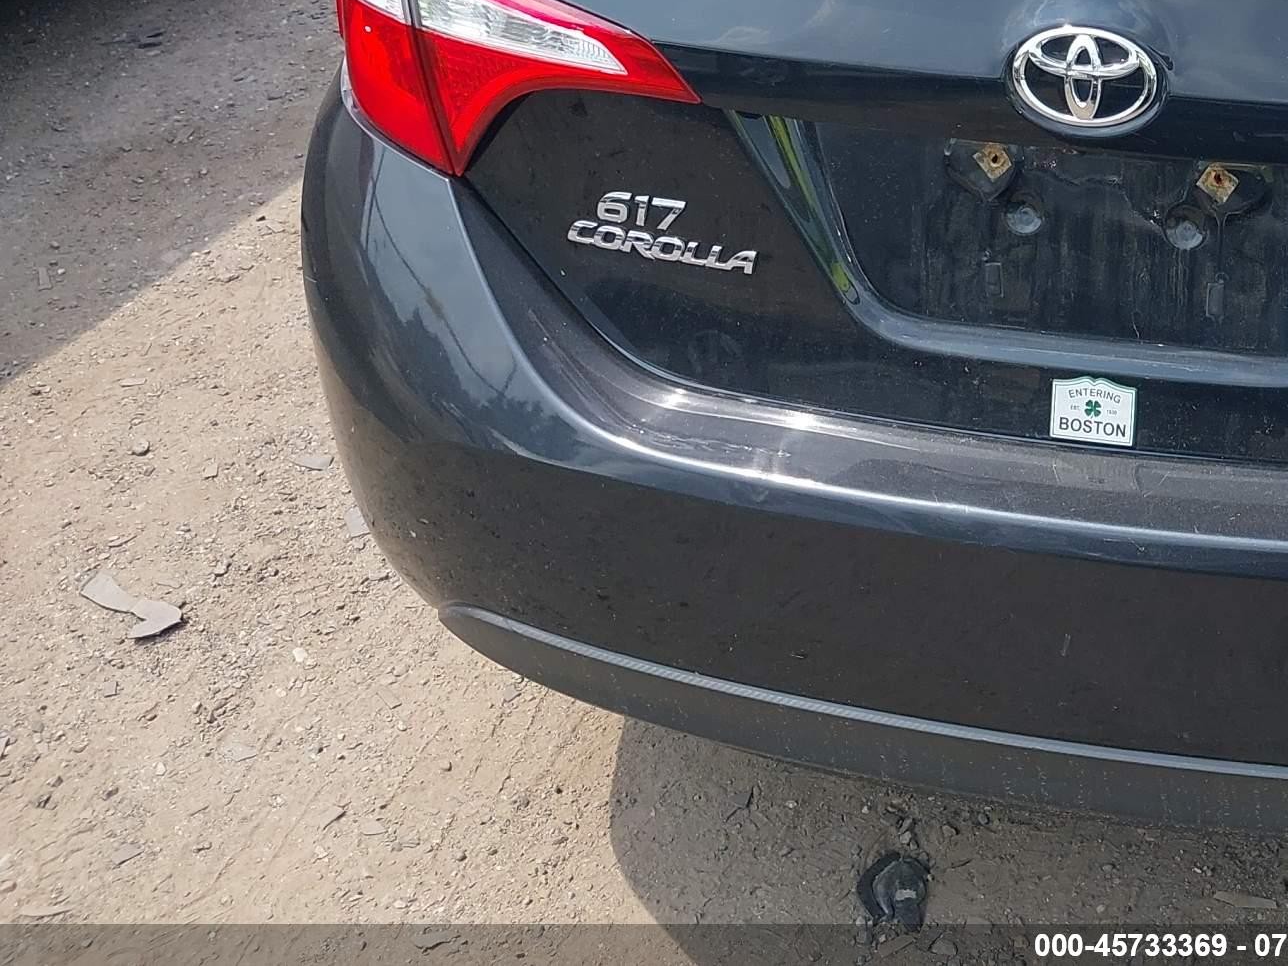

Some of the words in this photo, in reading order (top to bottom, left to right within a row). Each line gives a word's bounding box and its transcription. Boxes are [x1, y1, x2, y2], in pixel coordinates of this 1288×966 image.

[597, 191, 687, 231] 617
[567, 220, 758, 275] COROLLA
[1068, 387, 1121, 404] ENTERING
[1059, 416, 1126, 438] BOSTON
